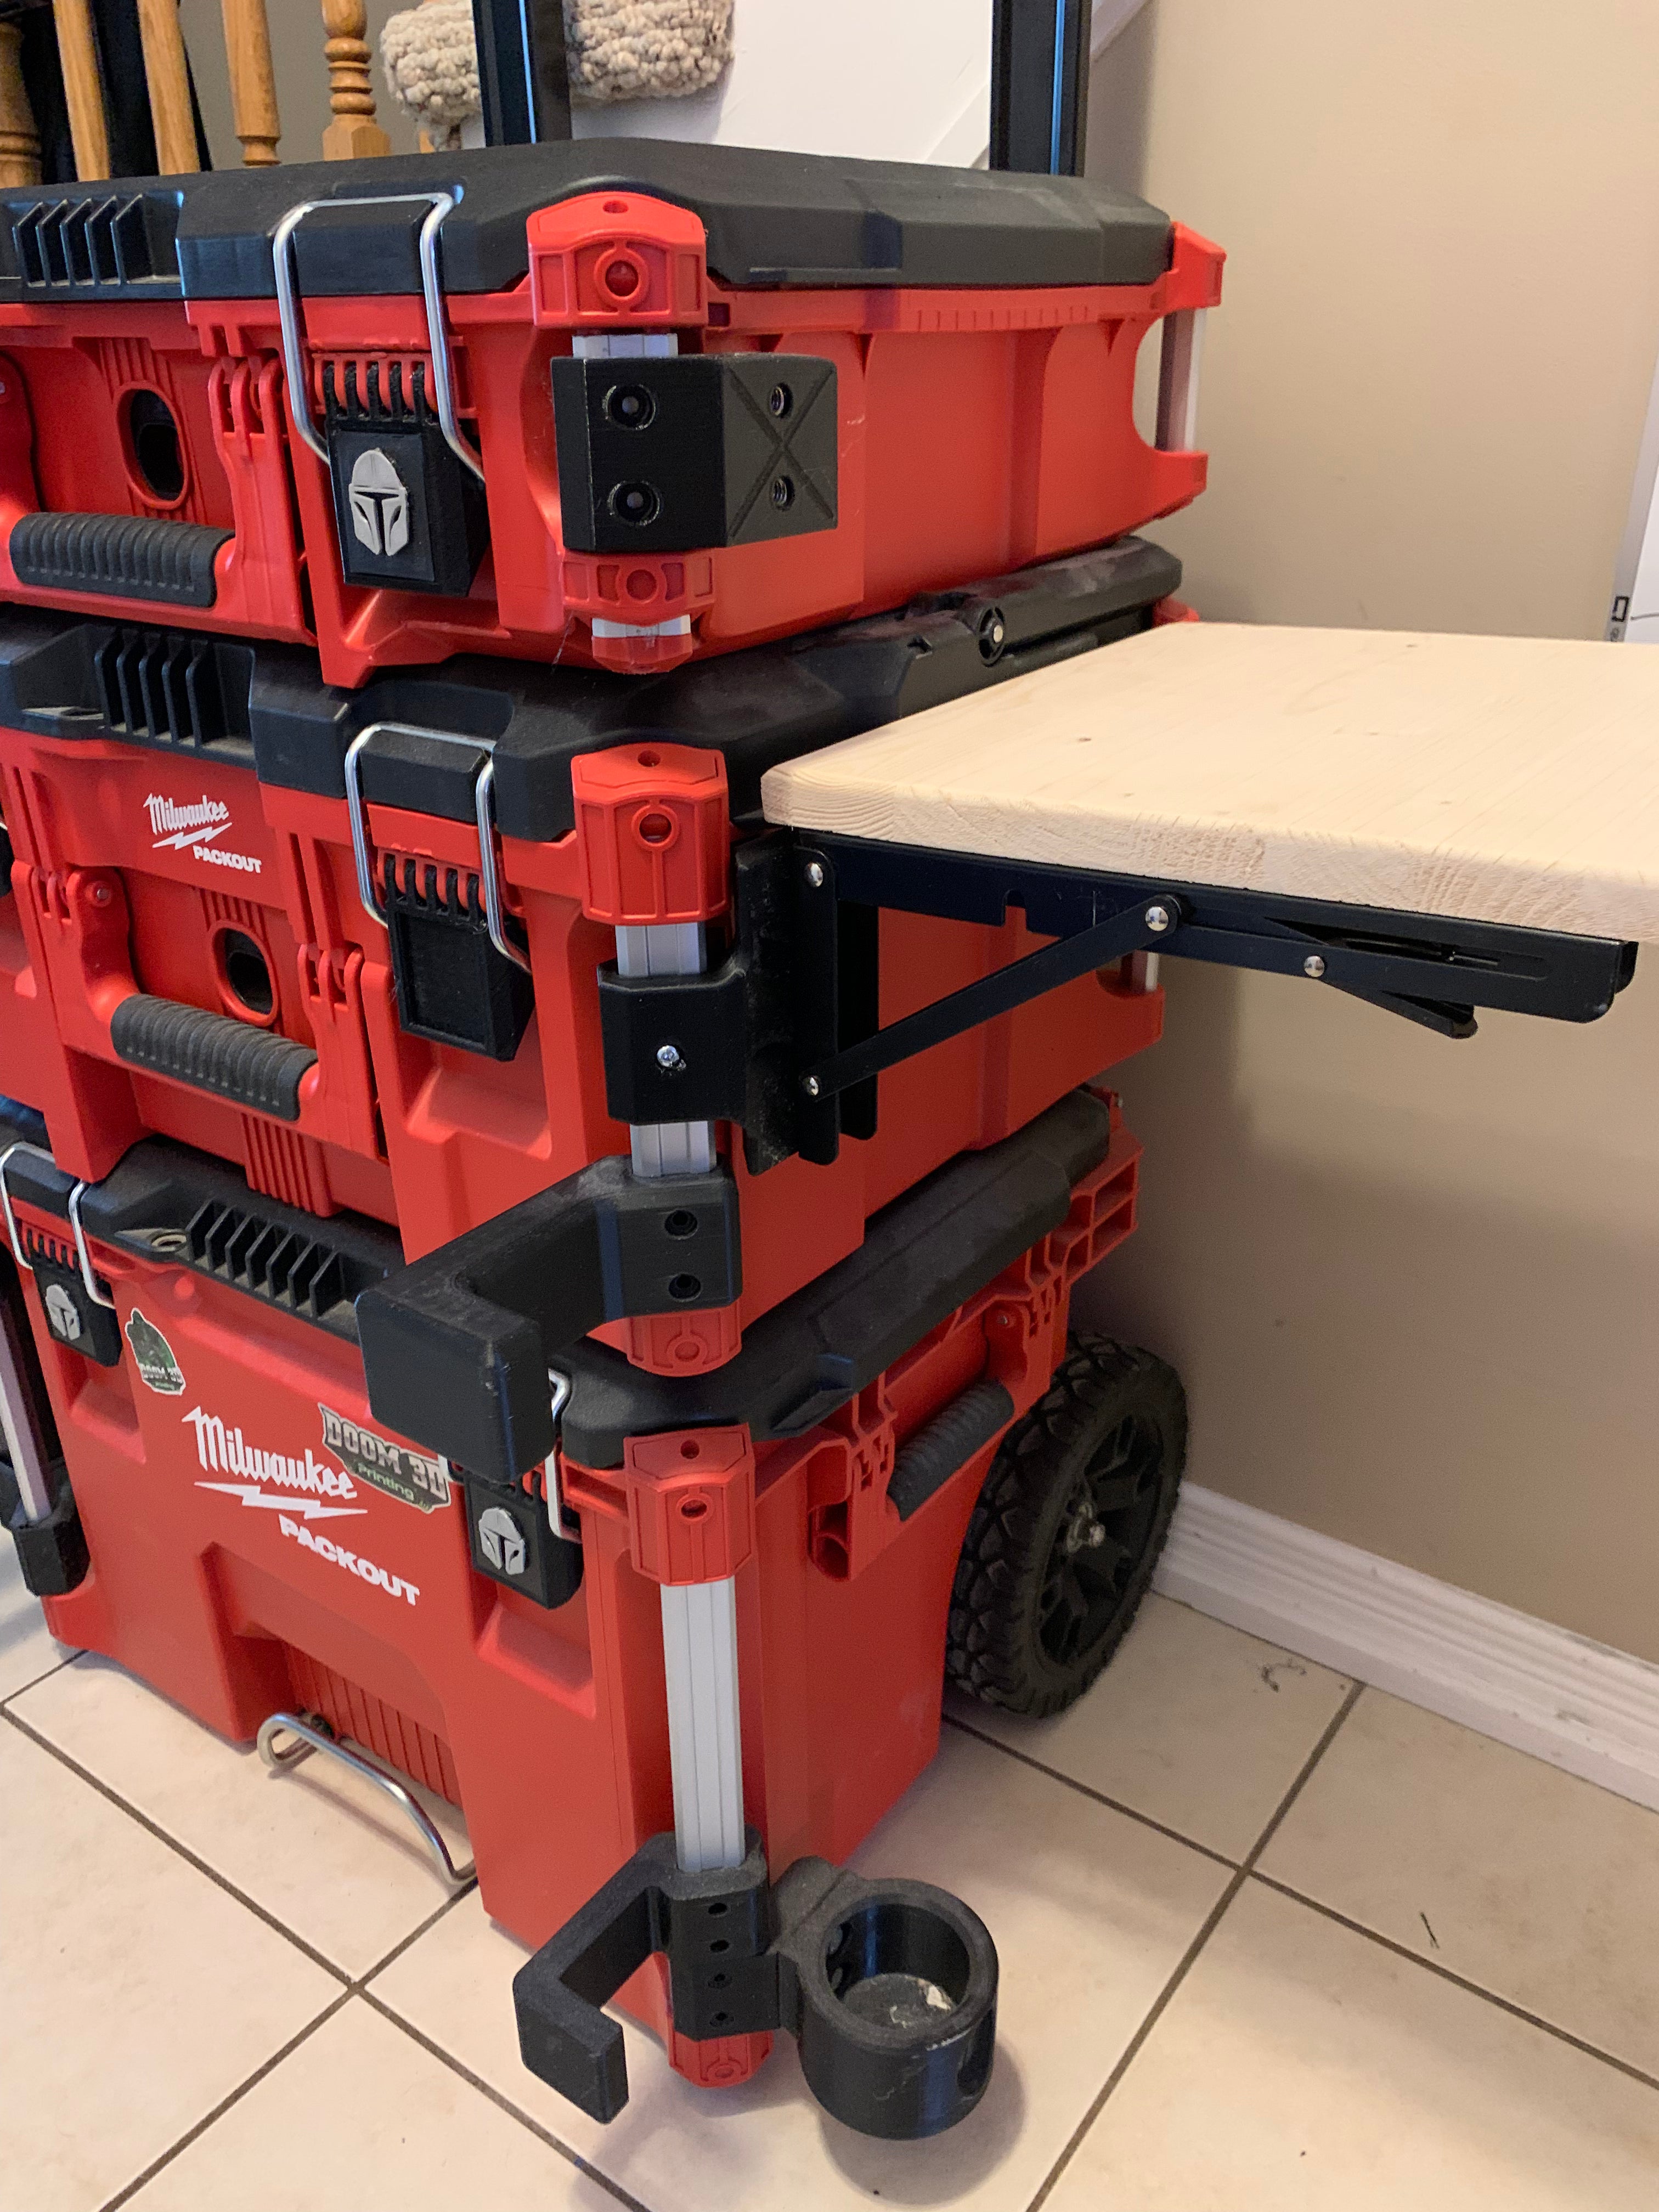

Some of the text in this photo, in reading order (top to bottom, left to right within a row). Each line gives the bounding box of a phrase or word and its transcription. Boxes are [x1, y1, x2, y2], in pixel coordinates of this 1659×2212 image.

[143, 793, 229, 835] Milwaukee
[193, 845, 262, 873] PACKOUT
[182, 1406, 357, 1499] Milwaukee
[323, 1408, 448, 1501] DOOM 3D
[279, 1514, 420, 1605] PACKOUT
